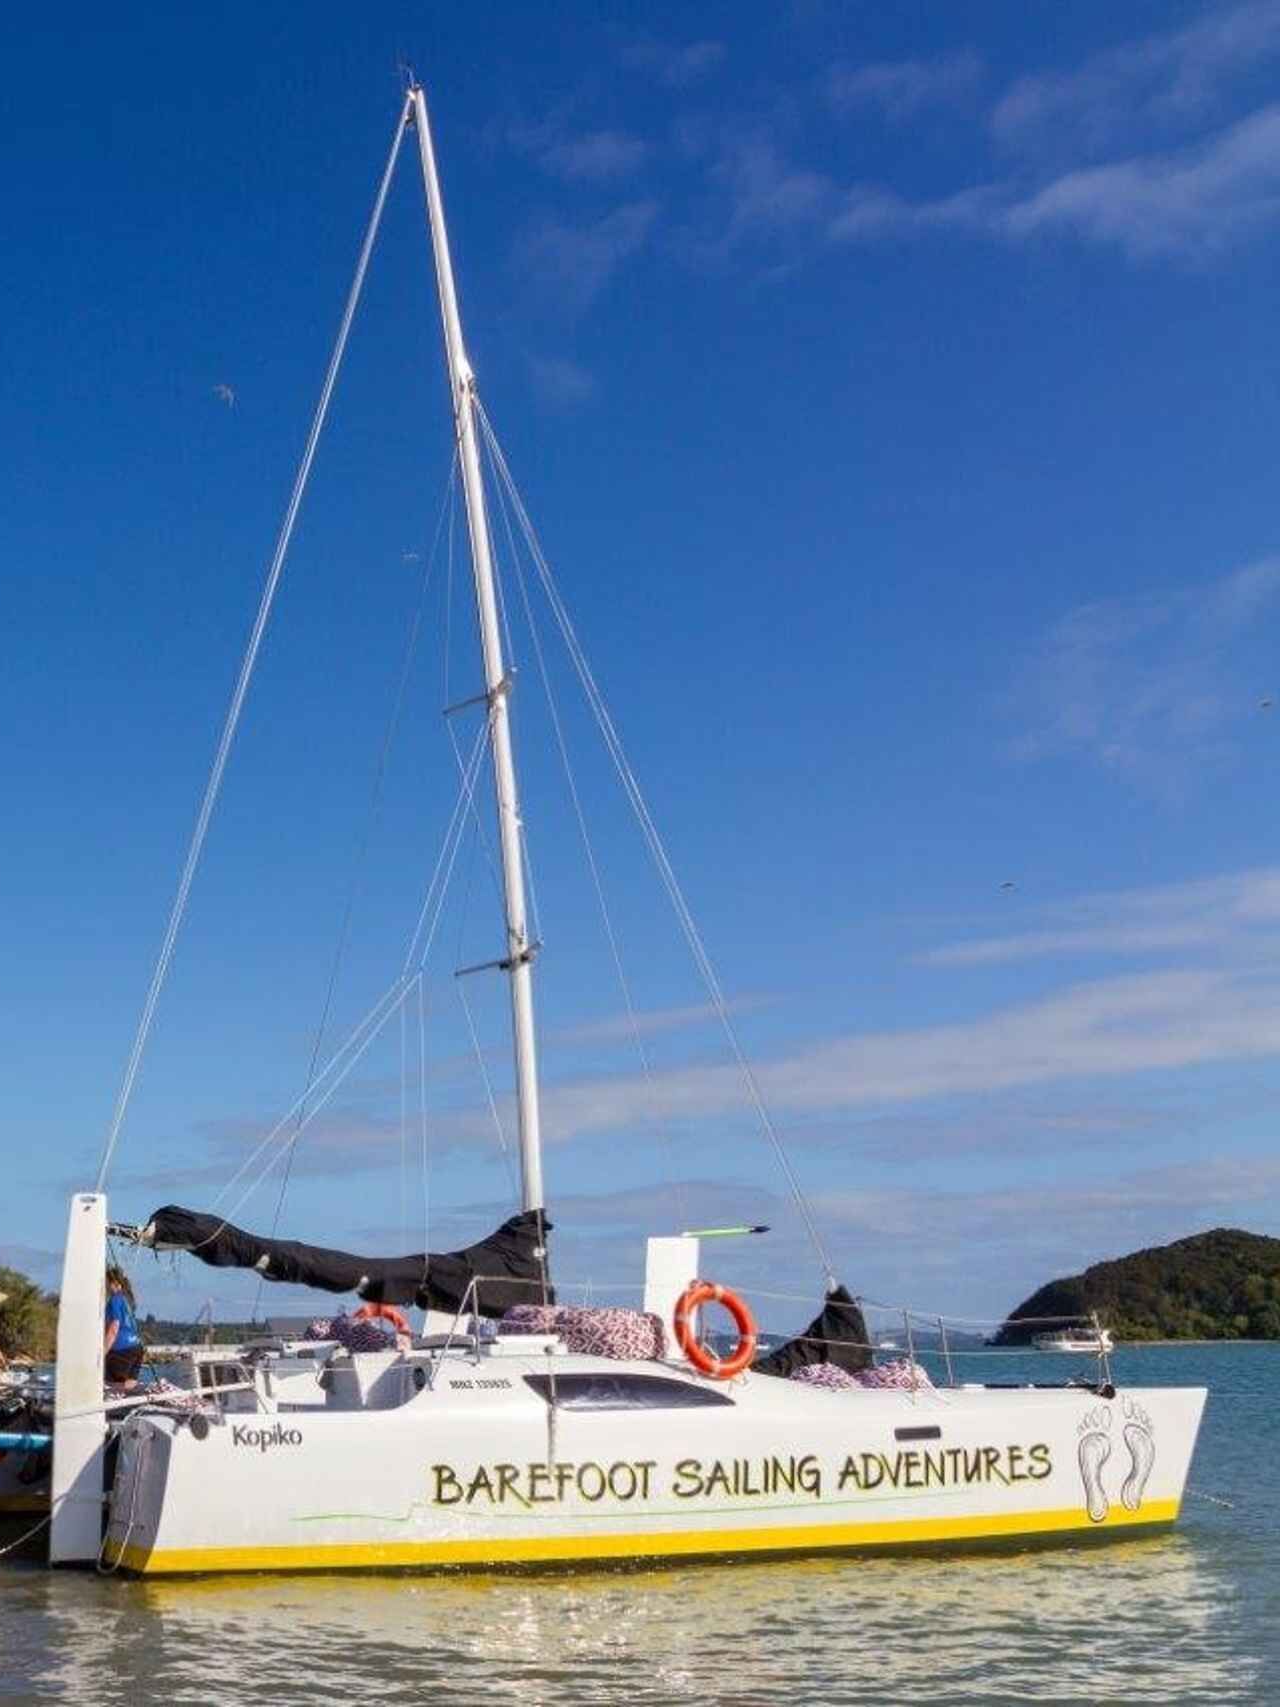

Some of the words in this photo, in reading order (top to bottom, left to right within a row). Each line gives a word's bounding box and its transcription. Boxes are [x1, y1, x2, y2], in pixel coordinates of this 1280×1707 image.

[232, 1421, 303, 1453] Kopiko
[431, 1460, 657, 1508] BAREFOOT
[671, 1454, 822, 1499] SAILING
[837, 1443, 1053, 1491] ADVENTURES
